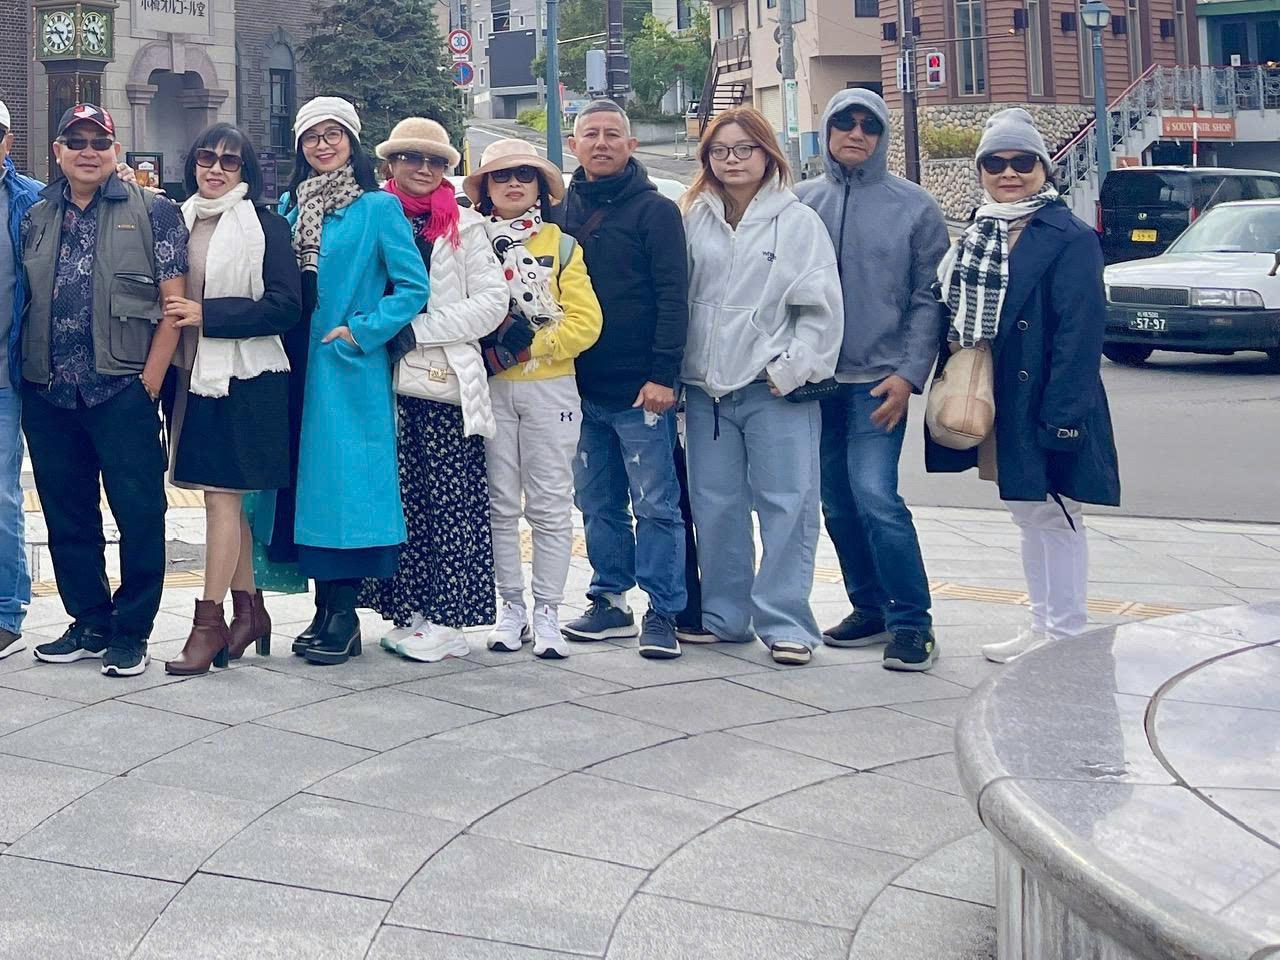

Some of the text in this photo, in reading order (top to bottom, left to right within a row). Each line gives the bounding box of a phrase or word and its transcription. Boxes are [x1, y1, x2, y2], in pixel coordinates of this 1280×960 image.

[453, 36, 467, 47] 30
[1171, 122, 1232, 132] SOUVNIR SHOP
[1136, 318, 1166, 330] 57-97
